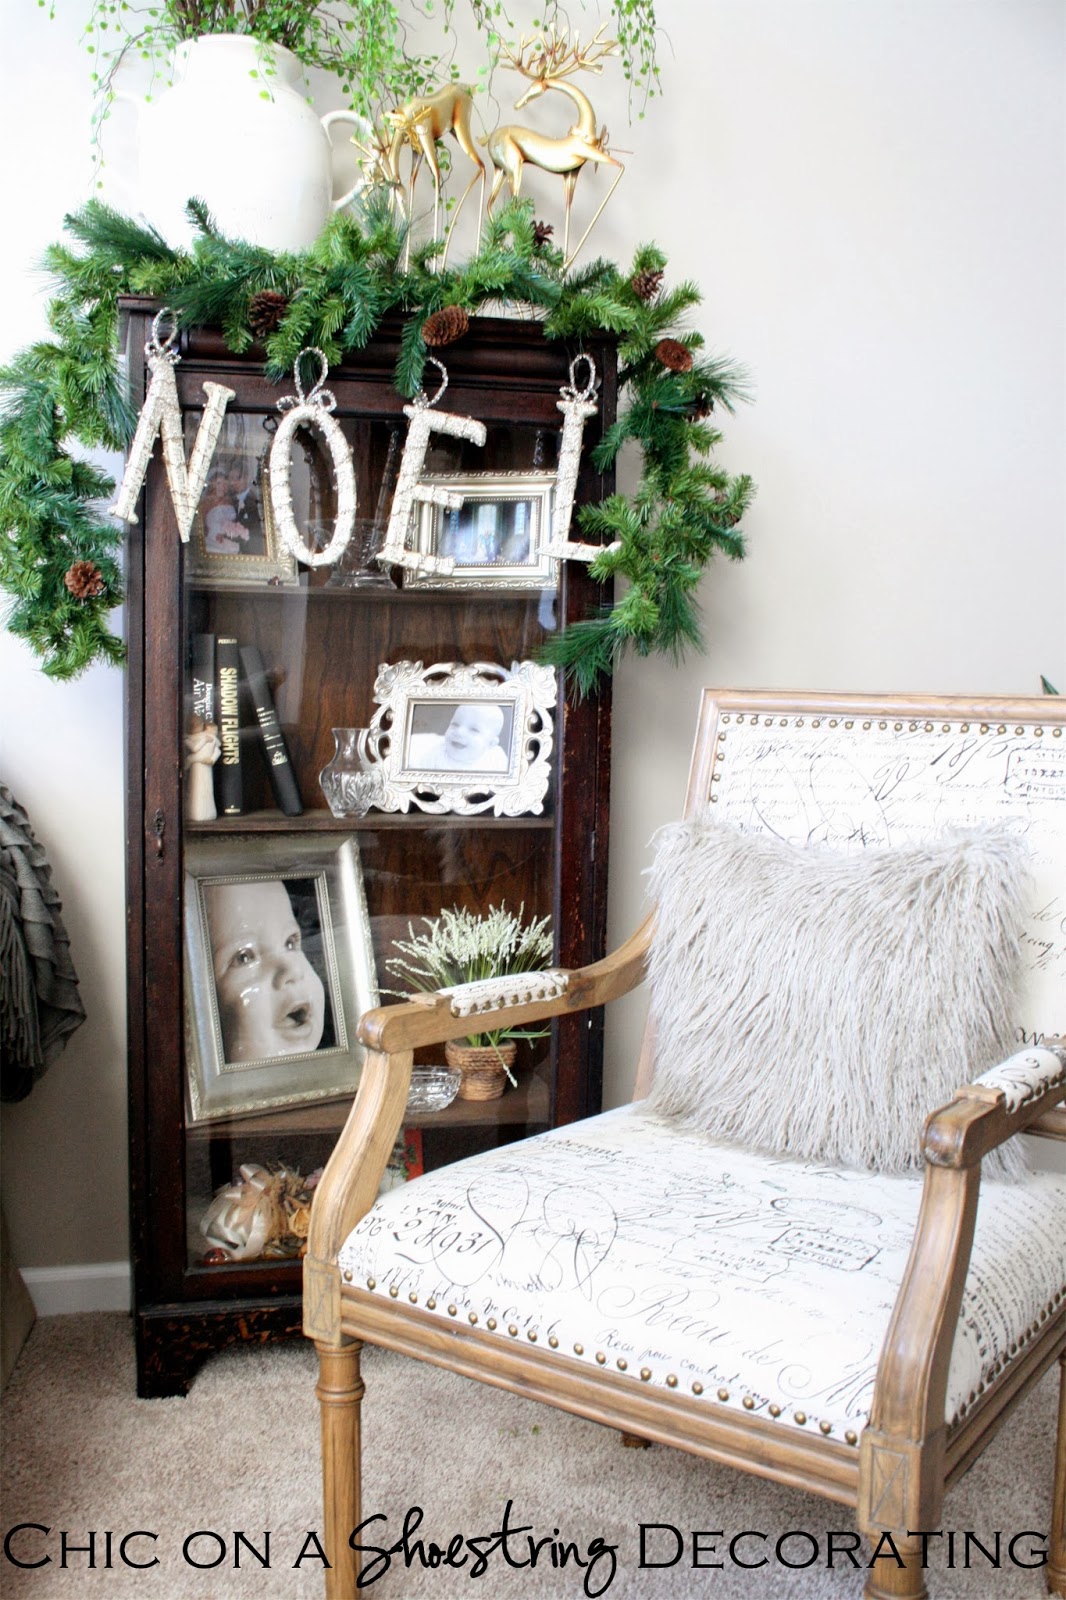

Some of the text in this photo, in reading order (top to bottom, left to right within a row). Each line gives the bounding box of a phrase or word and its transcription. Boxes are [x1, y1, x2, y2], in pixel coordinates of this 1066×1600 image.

[108, 350, 623, 577] NOEL
[193, 678, 205, 697] Air
[219, 667, 240, 765] SHADOW FLIGHTS
